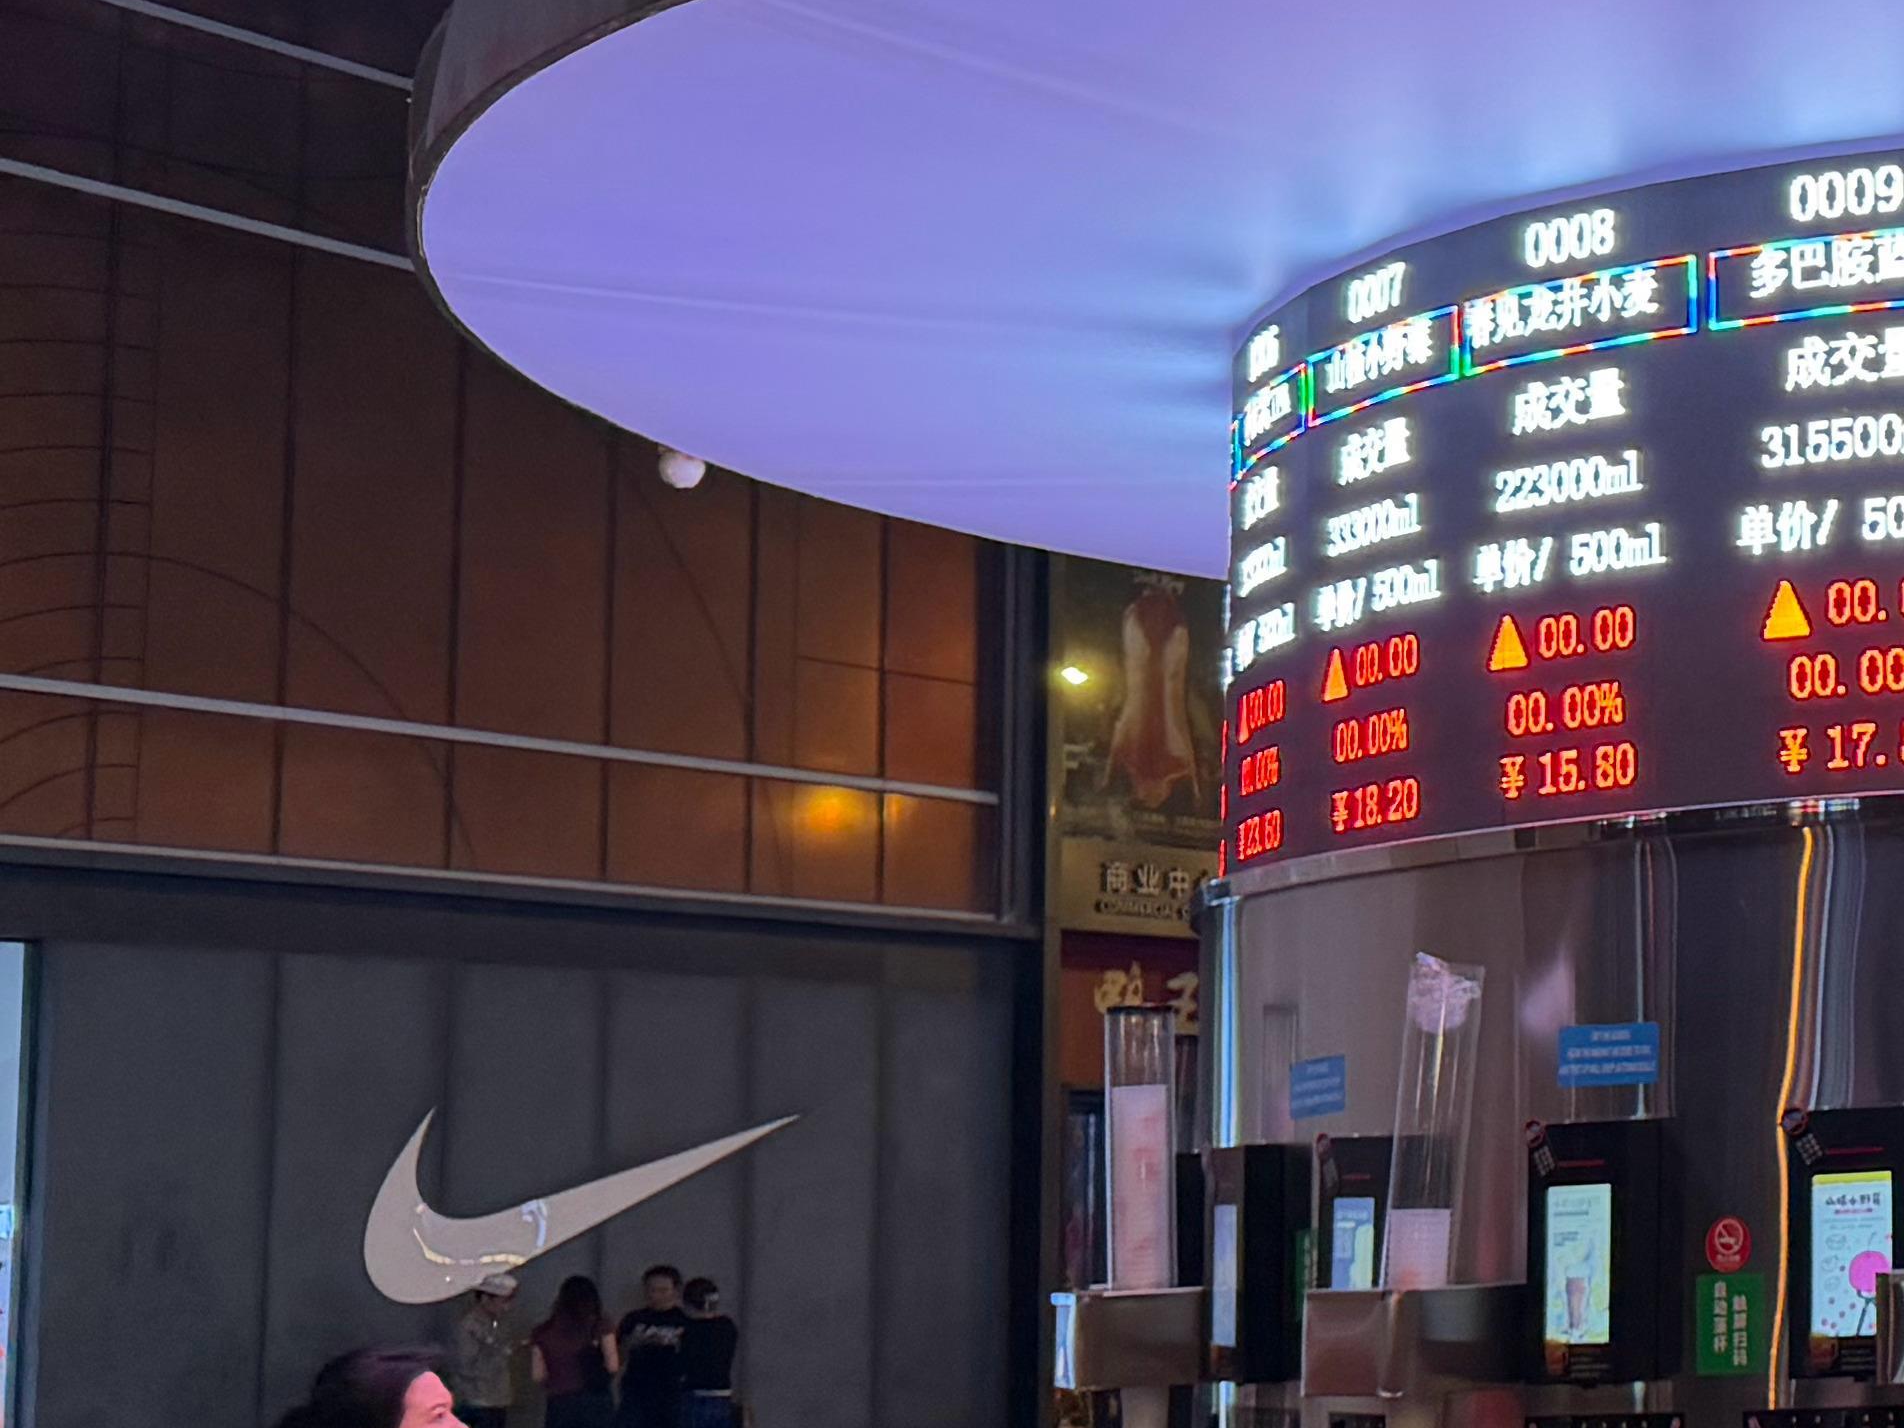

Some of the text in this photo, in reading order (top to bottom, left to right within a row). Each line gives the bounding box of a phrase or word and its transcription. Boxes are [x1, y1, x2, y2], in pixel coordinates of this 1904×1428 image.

[1789, 164, 1904, 222] 0009
[1524, 208, 1615, 269] 0008
[1512, 369, 1626, 436] 成交量
[1472, 522, 1668, 593] 单价/ 500ml
[1735, 498, 1839, 556] 单价/
